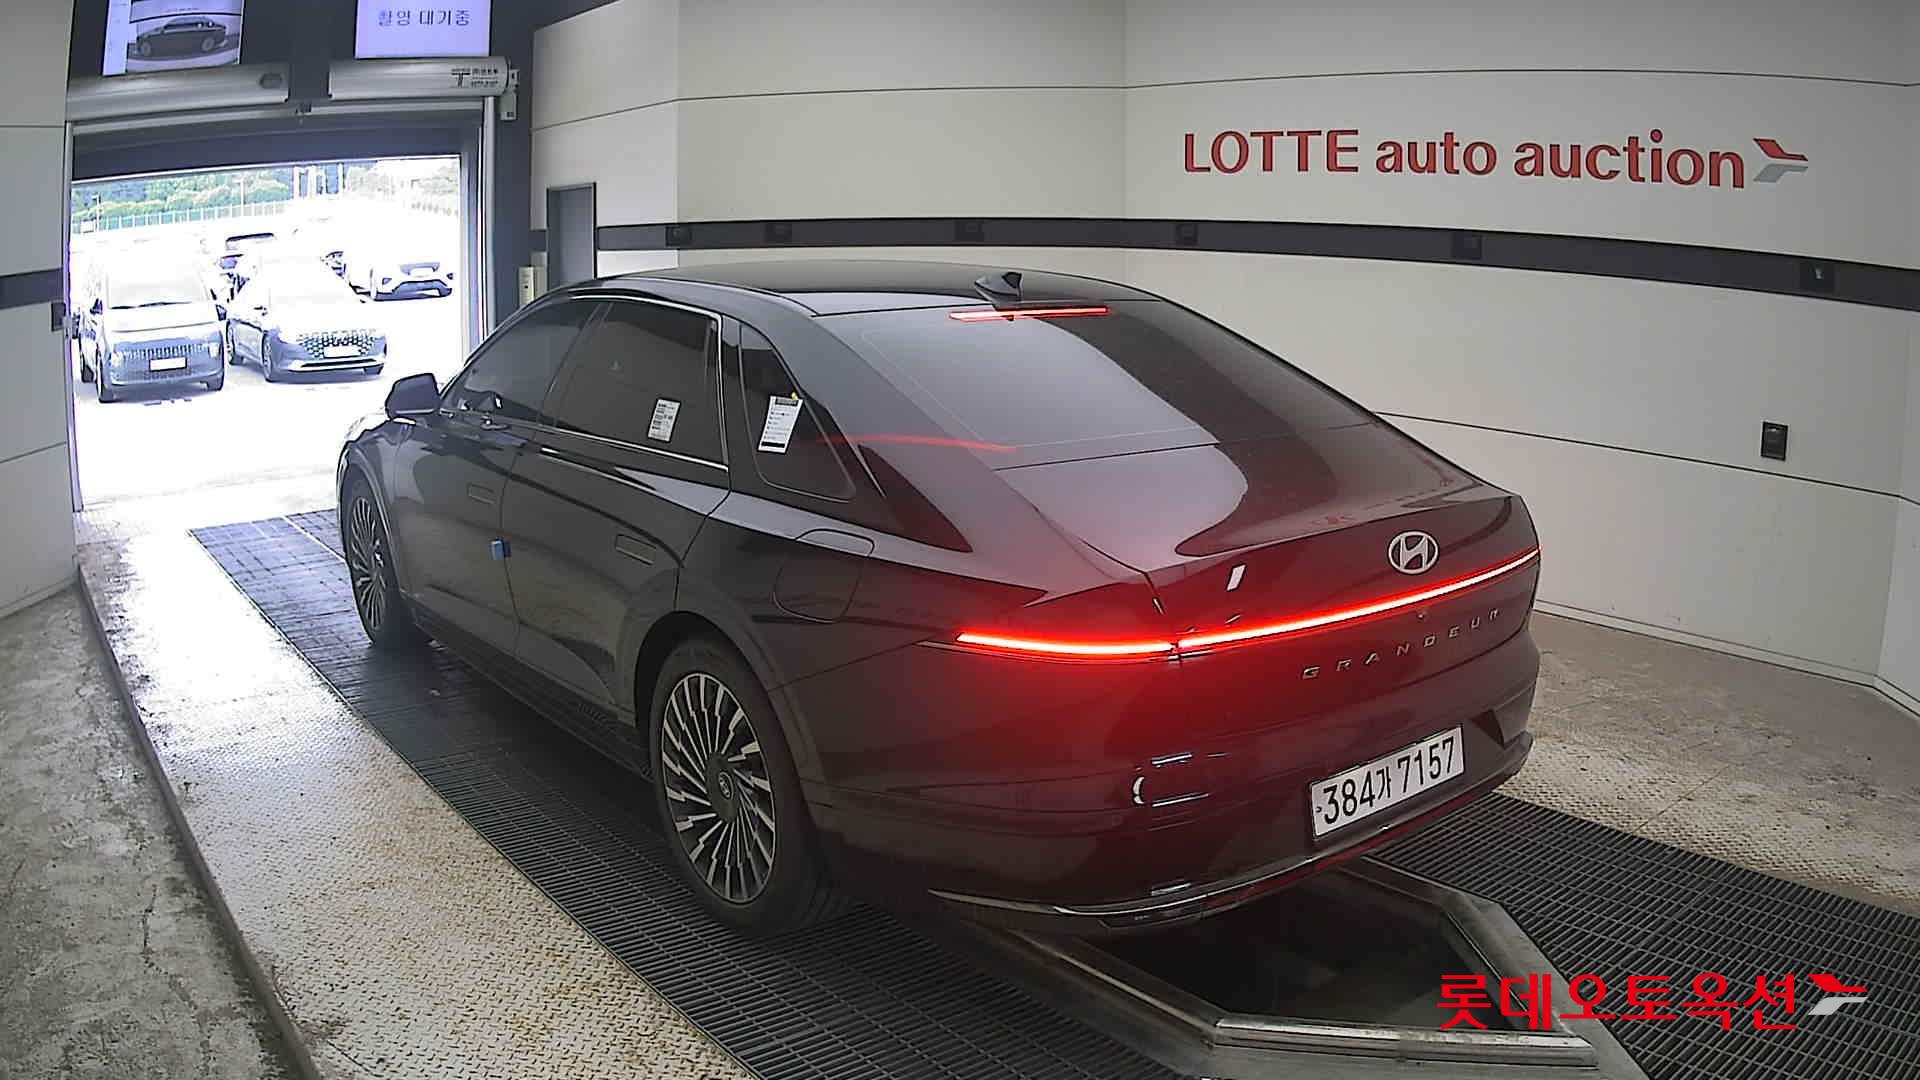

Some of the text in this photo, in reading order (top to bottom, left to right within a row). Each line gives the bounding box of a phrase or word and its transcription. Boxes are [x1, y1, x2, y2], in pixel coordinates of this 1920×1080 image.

[419, 9, 471, 26] 대기중
[1184, 129, 1745, 188] LOTTE auto auction
[1302, 608, 1499, 679] GRANDEUR
[1323, 736, 1454, 824] 384가 7157
